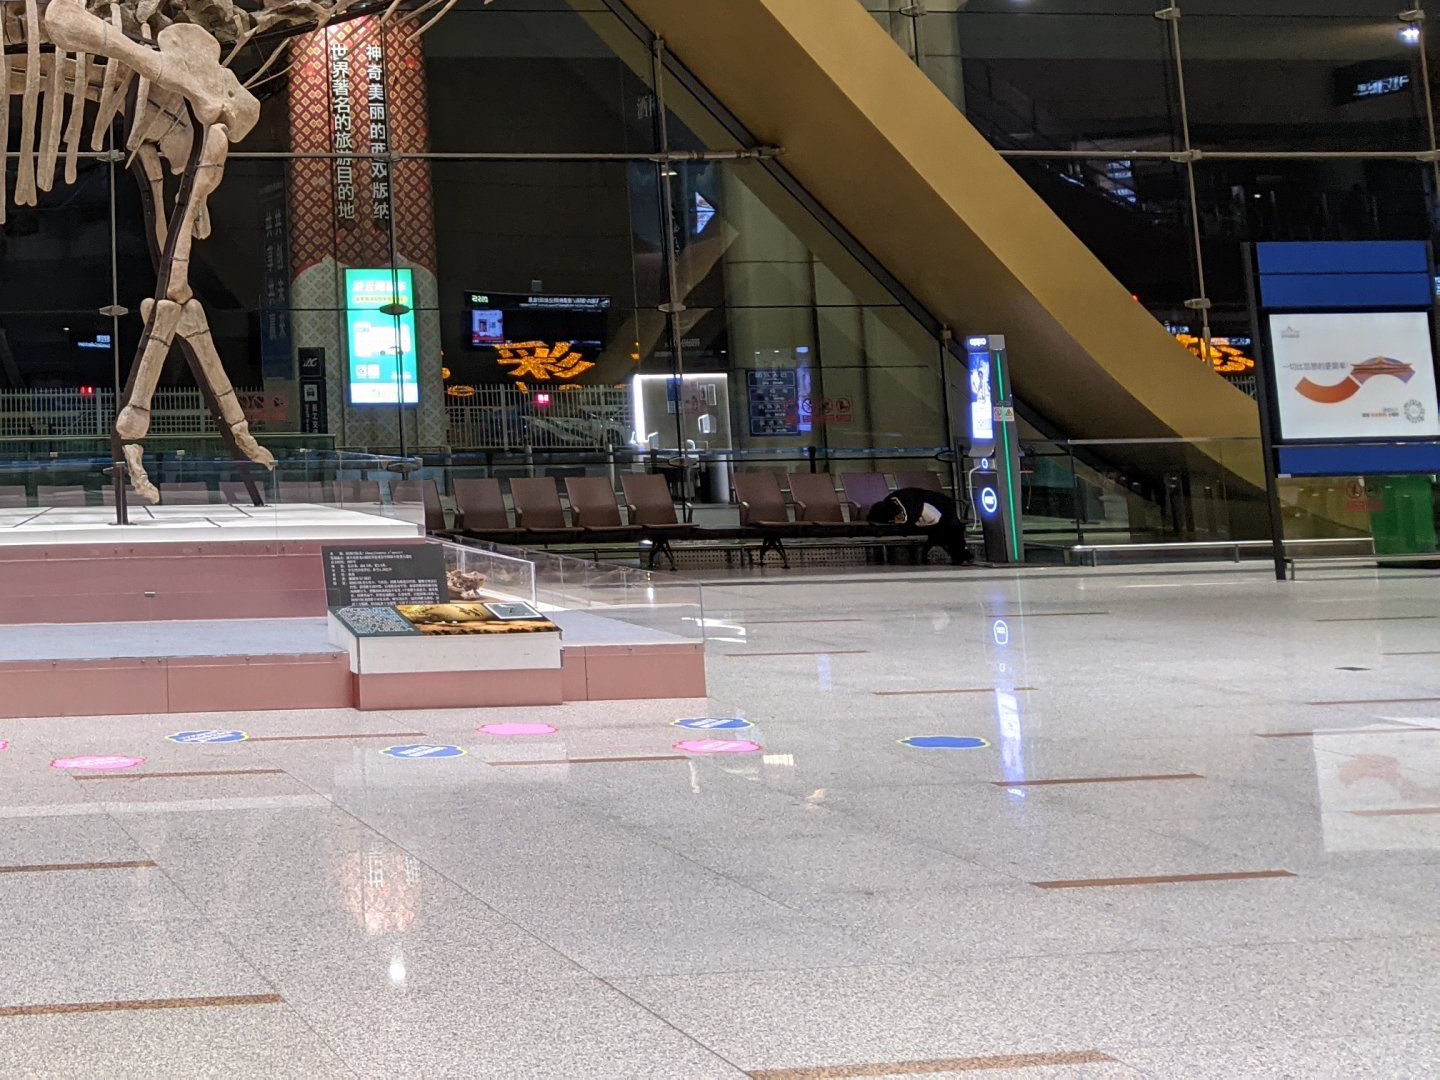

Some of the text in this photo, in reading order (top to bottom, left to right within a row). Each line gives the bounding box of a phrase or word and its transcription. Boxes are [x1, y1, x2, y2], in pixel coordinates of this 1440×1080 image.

[331, 44, 355, 220] 世界著名的旅游目的地
